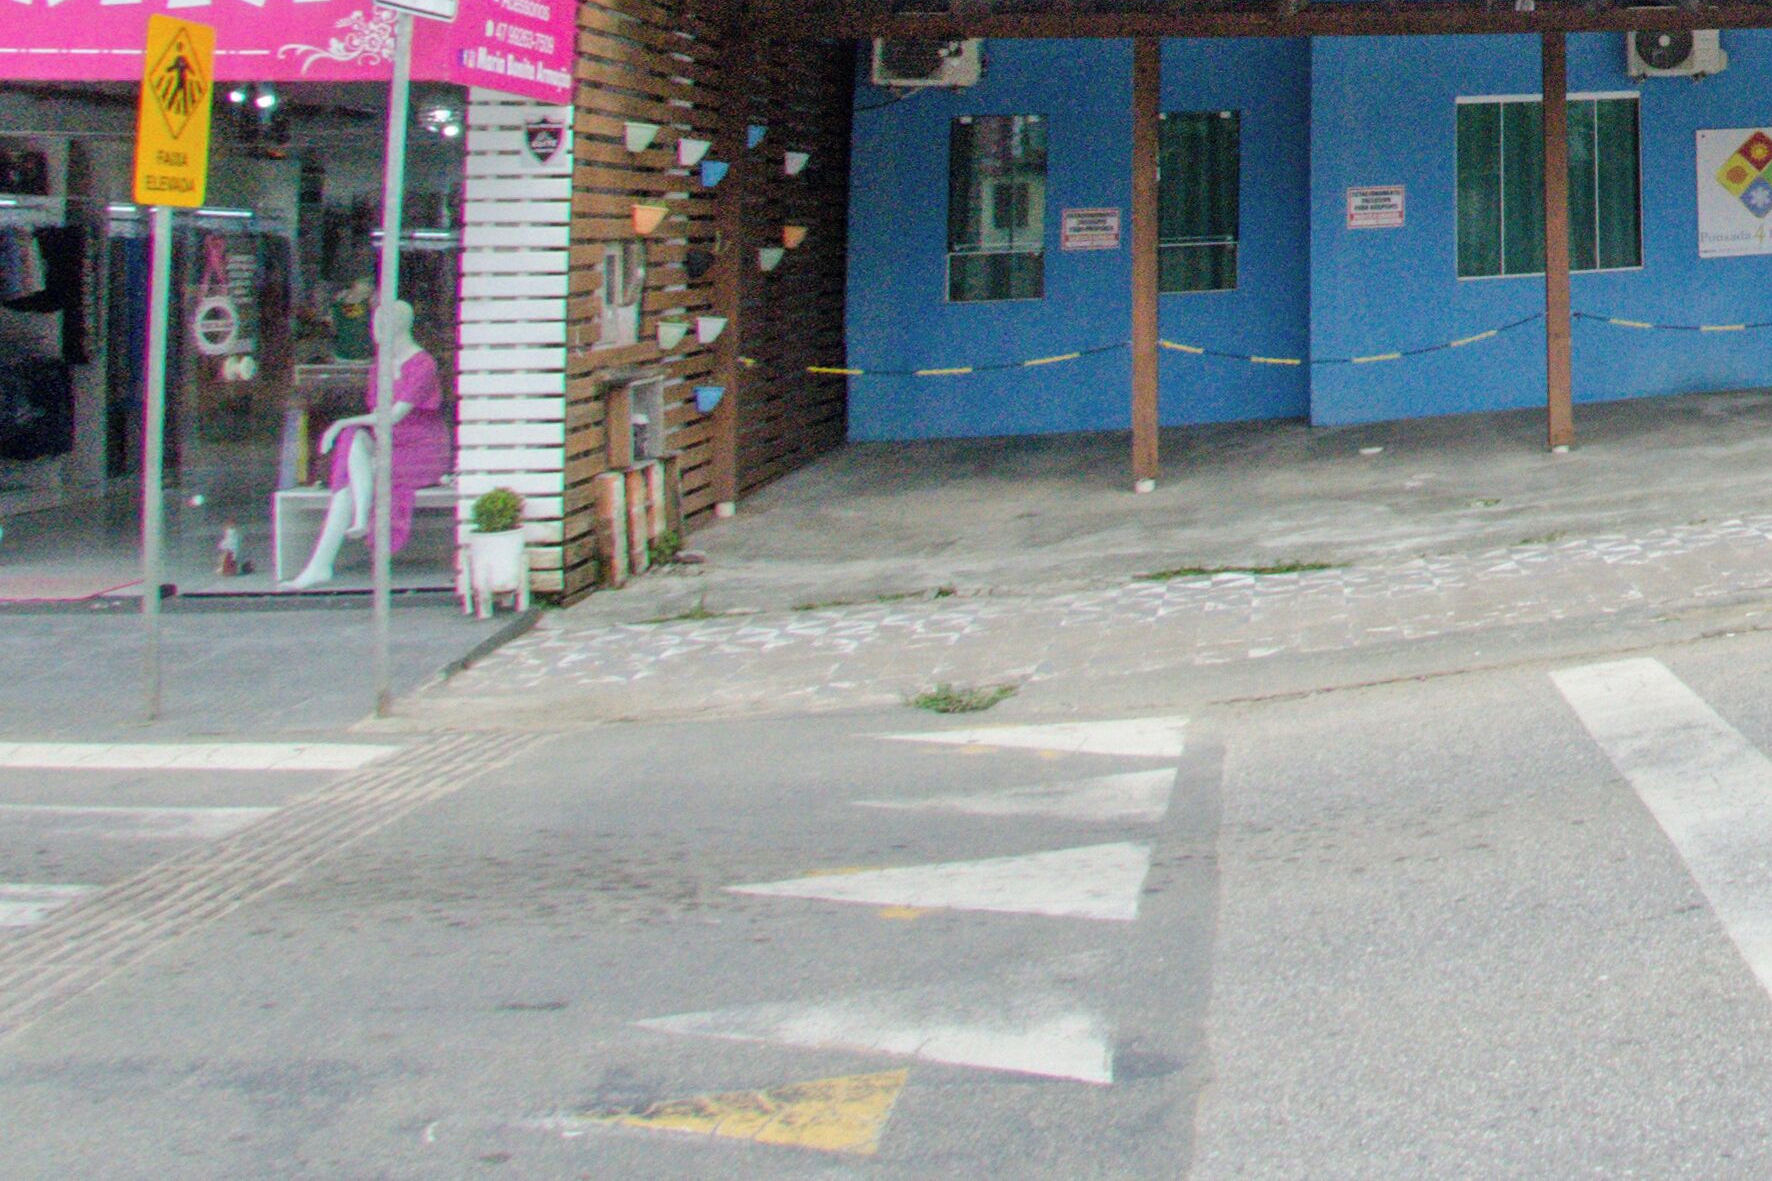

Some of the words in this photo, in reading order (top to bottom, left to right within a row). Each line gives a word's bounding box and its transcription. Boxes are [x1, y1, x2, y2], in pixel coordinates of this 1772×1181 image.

[146, 174, 196, 193] ELEVADA
[1700, 229, 1751, 243] Pousada
[1753, 223, 1766, 247] 4
